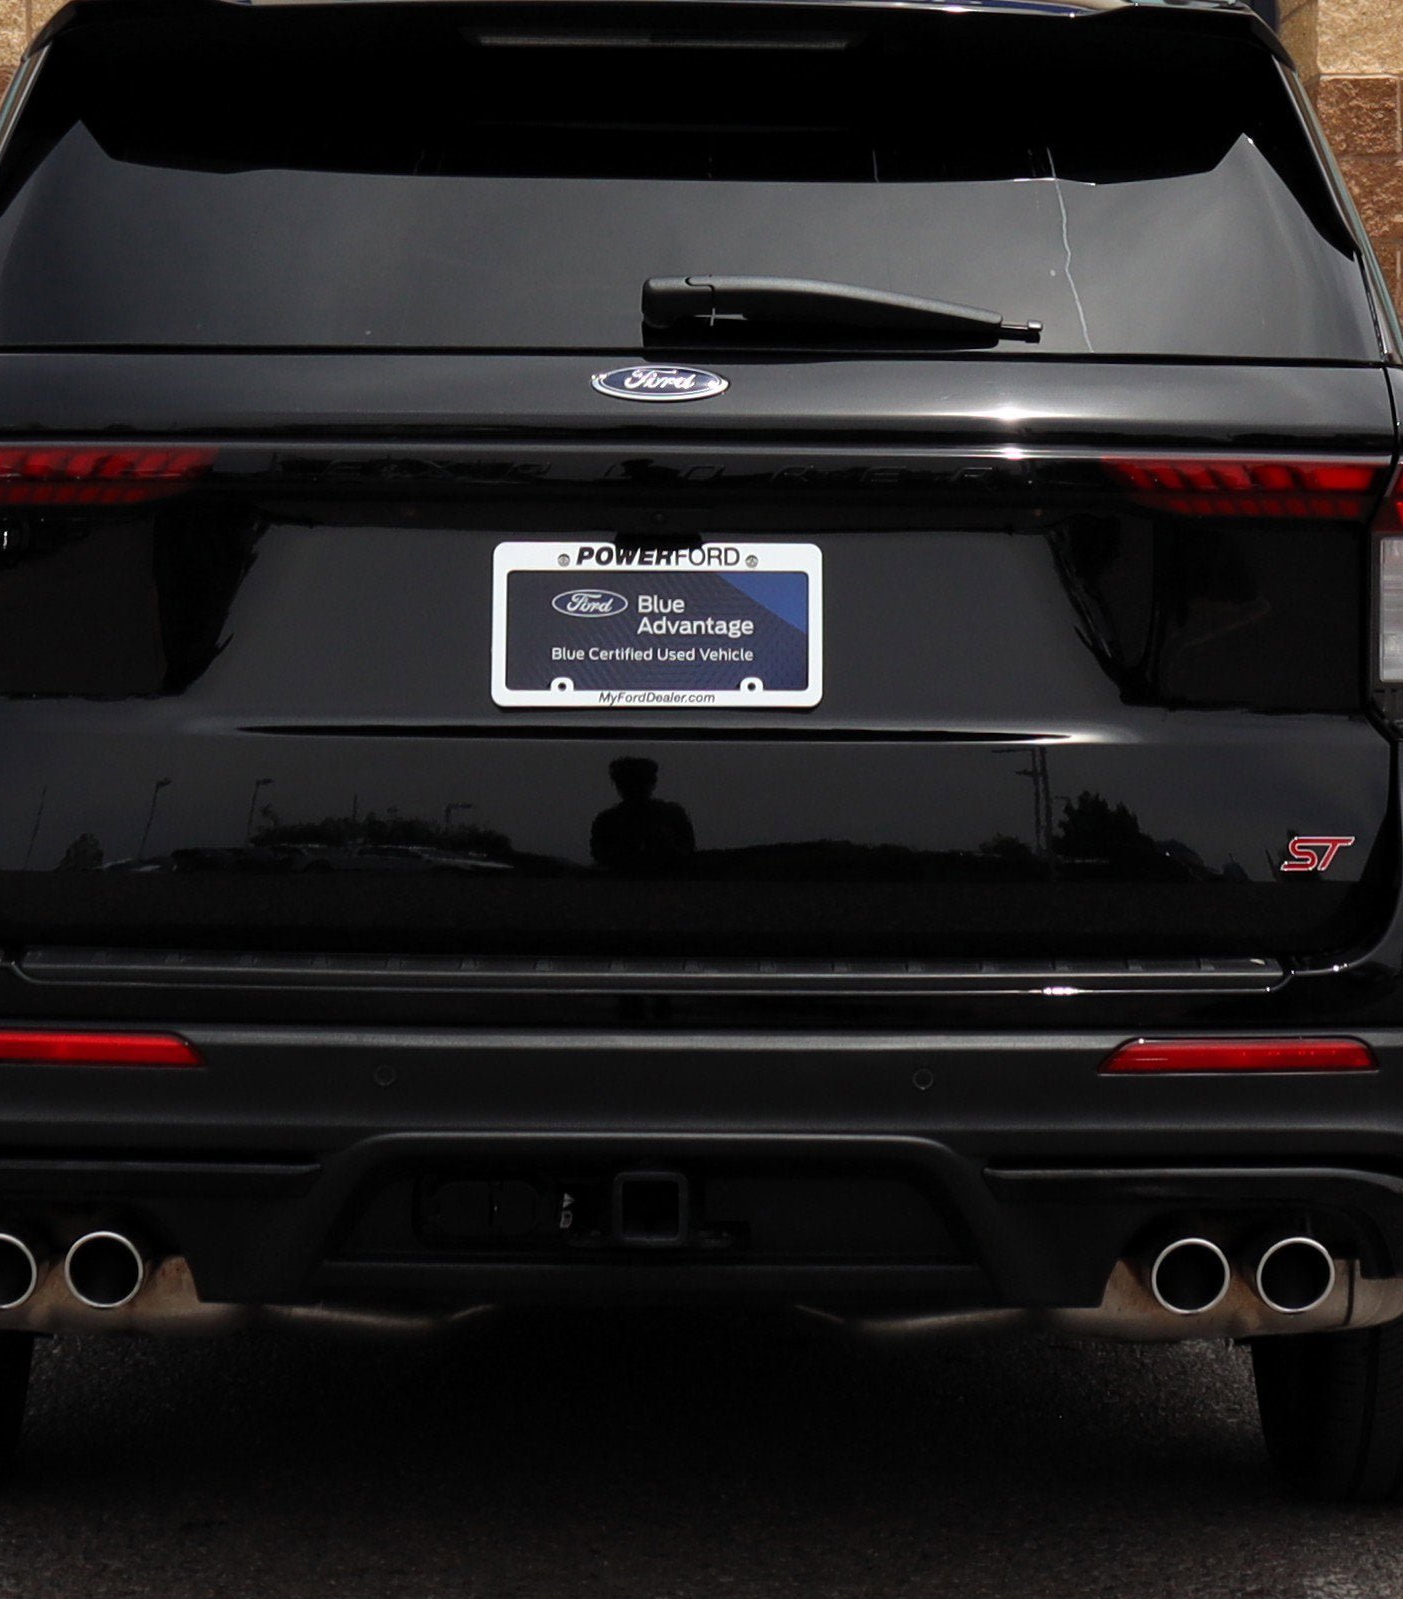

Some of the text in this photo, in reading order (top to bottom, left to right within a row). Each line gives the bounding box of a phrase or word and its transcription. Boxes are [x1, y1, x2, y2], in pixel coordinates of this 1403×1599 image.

[623, 368, 697, 391] Ford
[575, 546, 741, 567] POWERFORD
[566, 592, 614, 614] Ford
[637, 594, 686, 614] Blue
[636, 615, 755, 639] Advantage
[551, 646, 754, 662] Blue Certified Used Vehicle
[597, 691, 716, 707] MyFordDealer.com
[1280, 835, 1356, 872] ST
